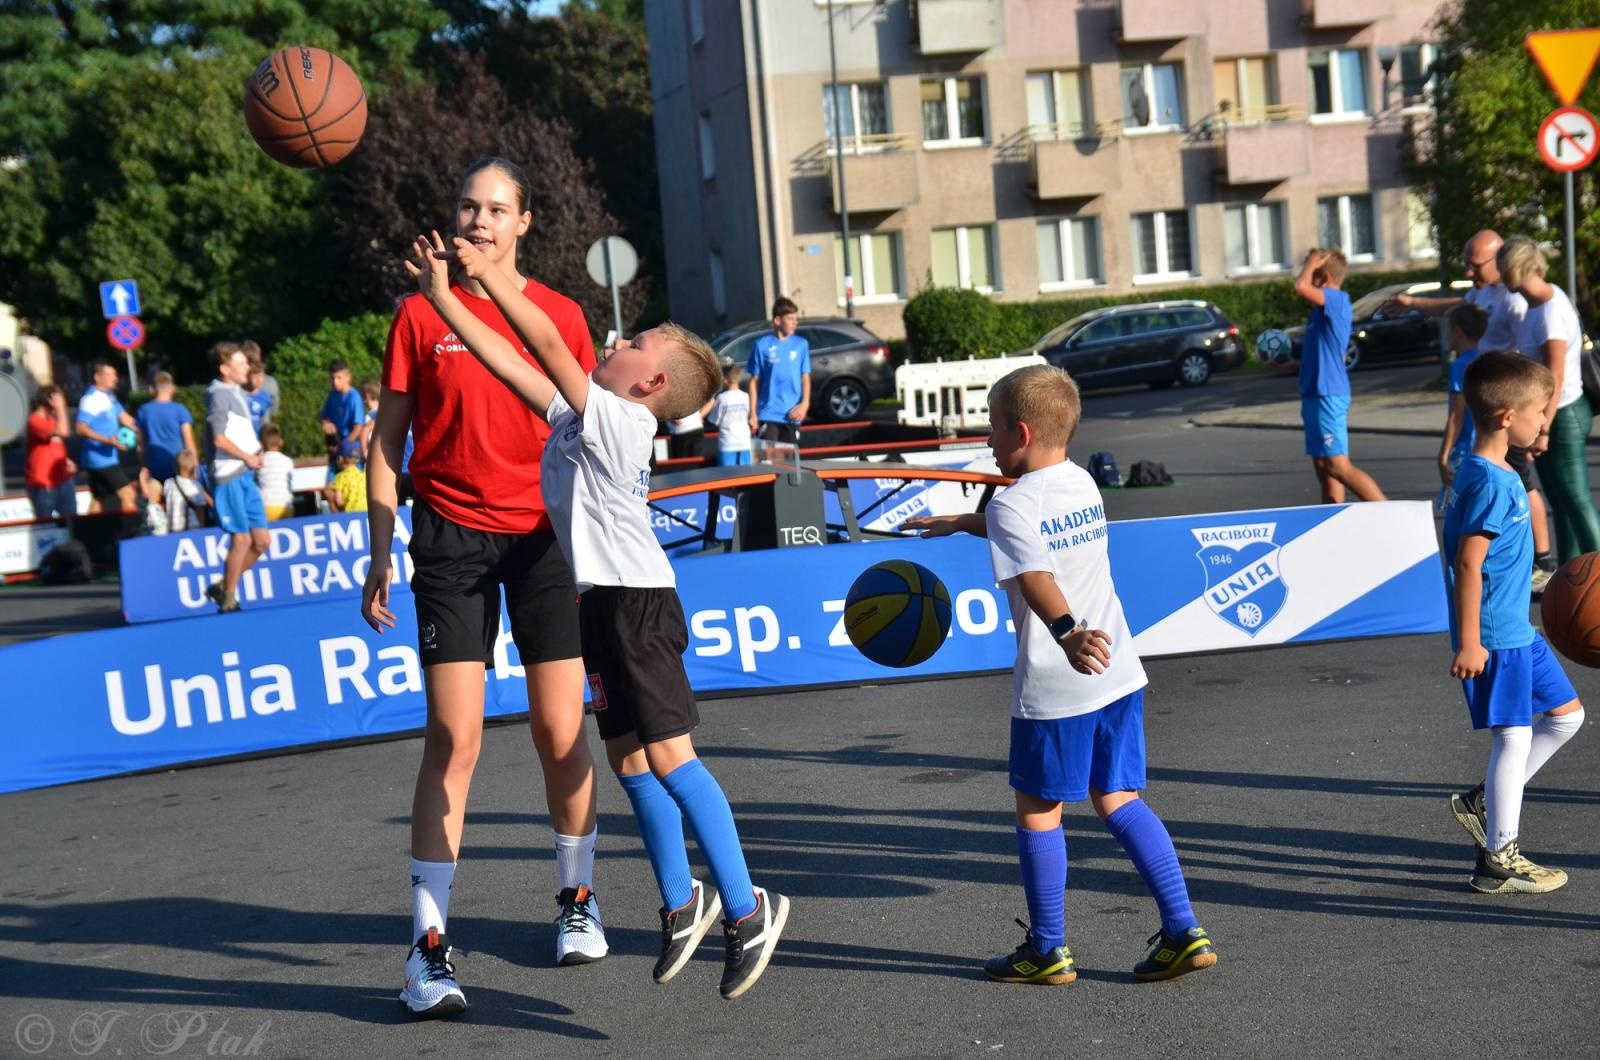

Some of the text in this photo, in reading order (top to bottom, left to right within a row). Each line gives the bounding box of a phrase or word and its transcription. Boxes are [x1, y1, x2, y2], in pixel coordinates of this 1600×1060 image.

[885, 498, 924, 524] UNIA
[1040, 503, 1105, 536] AKADEMI
[780, 526, 824, 546] TEQ
[1046, 538, 1069, 552] NIA
[1201, 526, 1270, 542] RACIBÓRZ
[1209, 554, 1232, 565] 1946
[1211, 562, 1274, 605] UNIA
[104, 651, 296, 736] Unia
[690, 604, 801, 672] sp.
